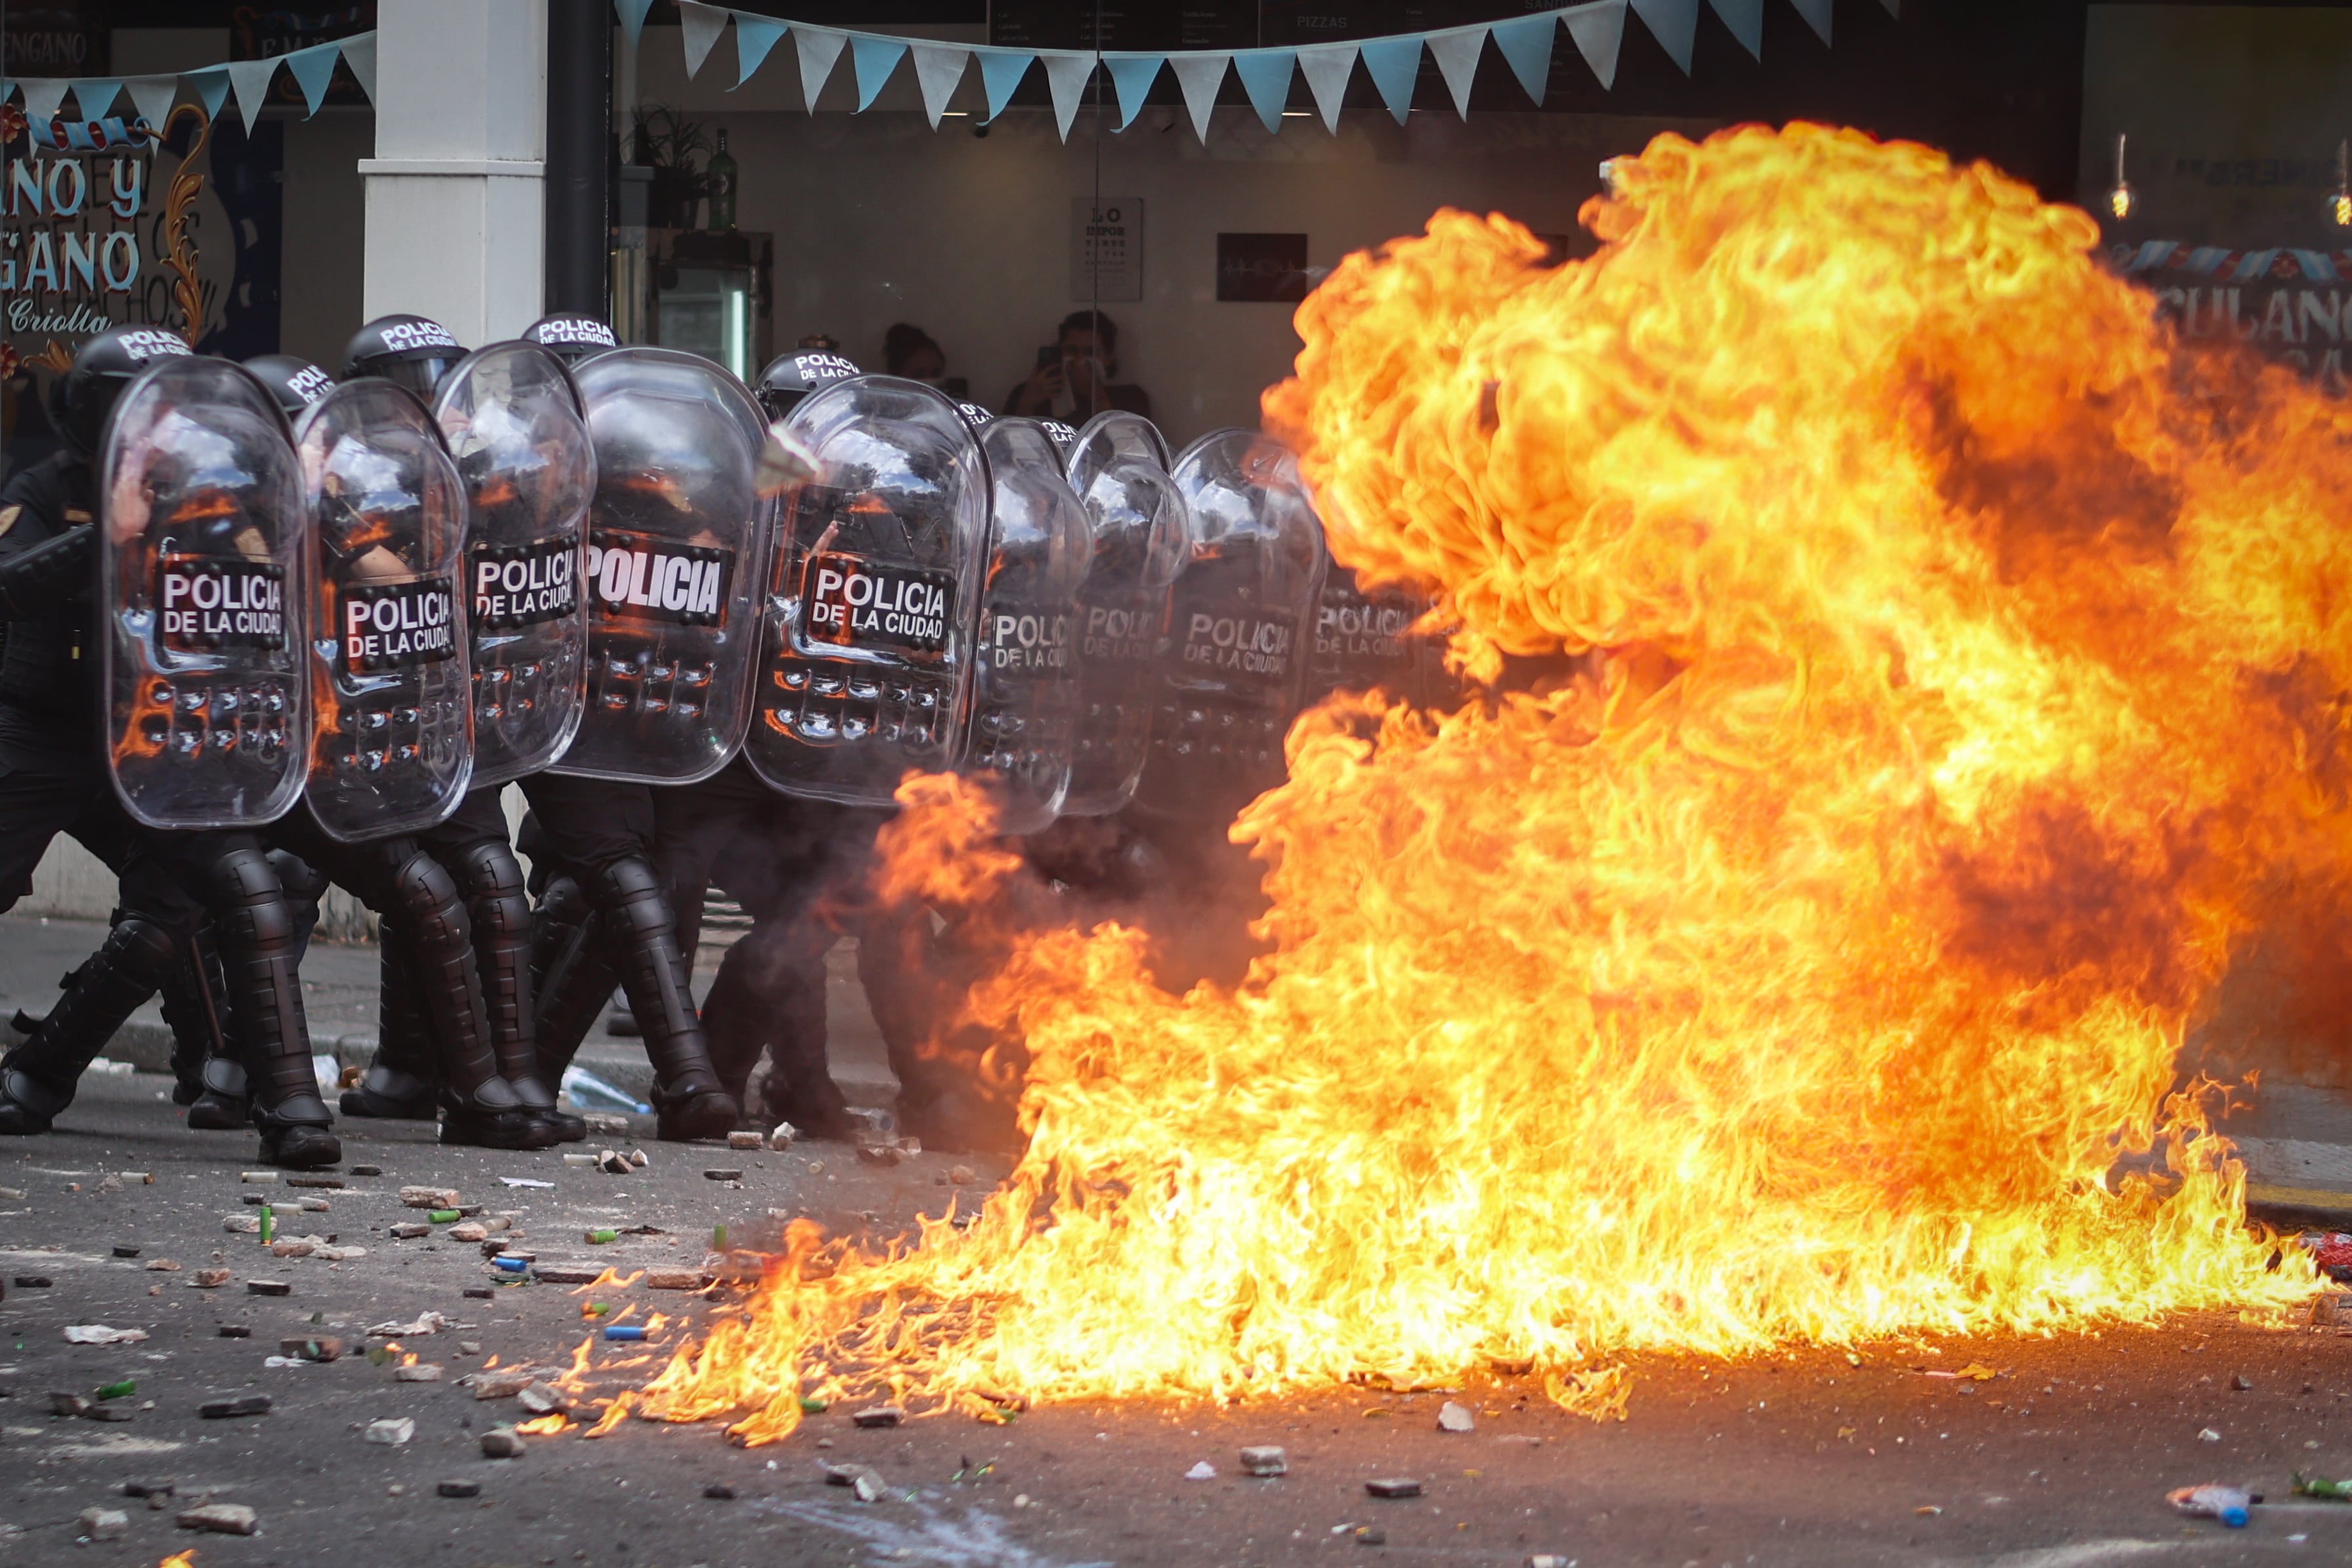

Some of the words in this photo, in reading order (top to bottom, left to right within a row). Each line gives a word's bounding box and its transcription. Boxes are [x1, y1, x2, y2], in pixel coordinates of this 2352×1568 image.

[1297, 16, 1347, 28] PIZZAS
[1, 158, 86, 218] NO
[8, 298, 113, 334] Criolla
[539, 319, 615, 339] POLICIA
[560, 333, 576, 342] LA
[800, 369, 817, 380] DE
[820, 368, 836, 377] LA
[164, 573, 282, 611] POLICIA
[583, 545, 720, 614] POLICIA
[476, 595, 506, 617] DE
[512, 592, 536, 615] LA
[815, 568, 944, 618] POLICIA
[164, 611, 198, 633] DE
[204, 611, 233, 634] LA
[347, 592, 450, 634] POLICIA
[812, 602, 846, 626] DE
[851, 608, 879, 630] LA
[885, 612, 943, 640] CIUDAD
[348, 635, 379, 658] DE
[385, 632, 412, 655] LA
[1183, 643, 1212, 666] DE
[1347, 637, 1370, 655] LA
